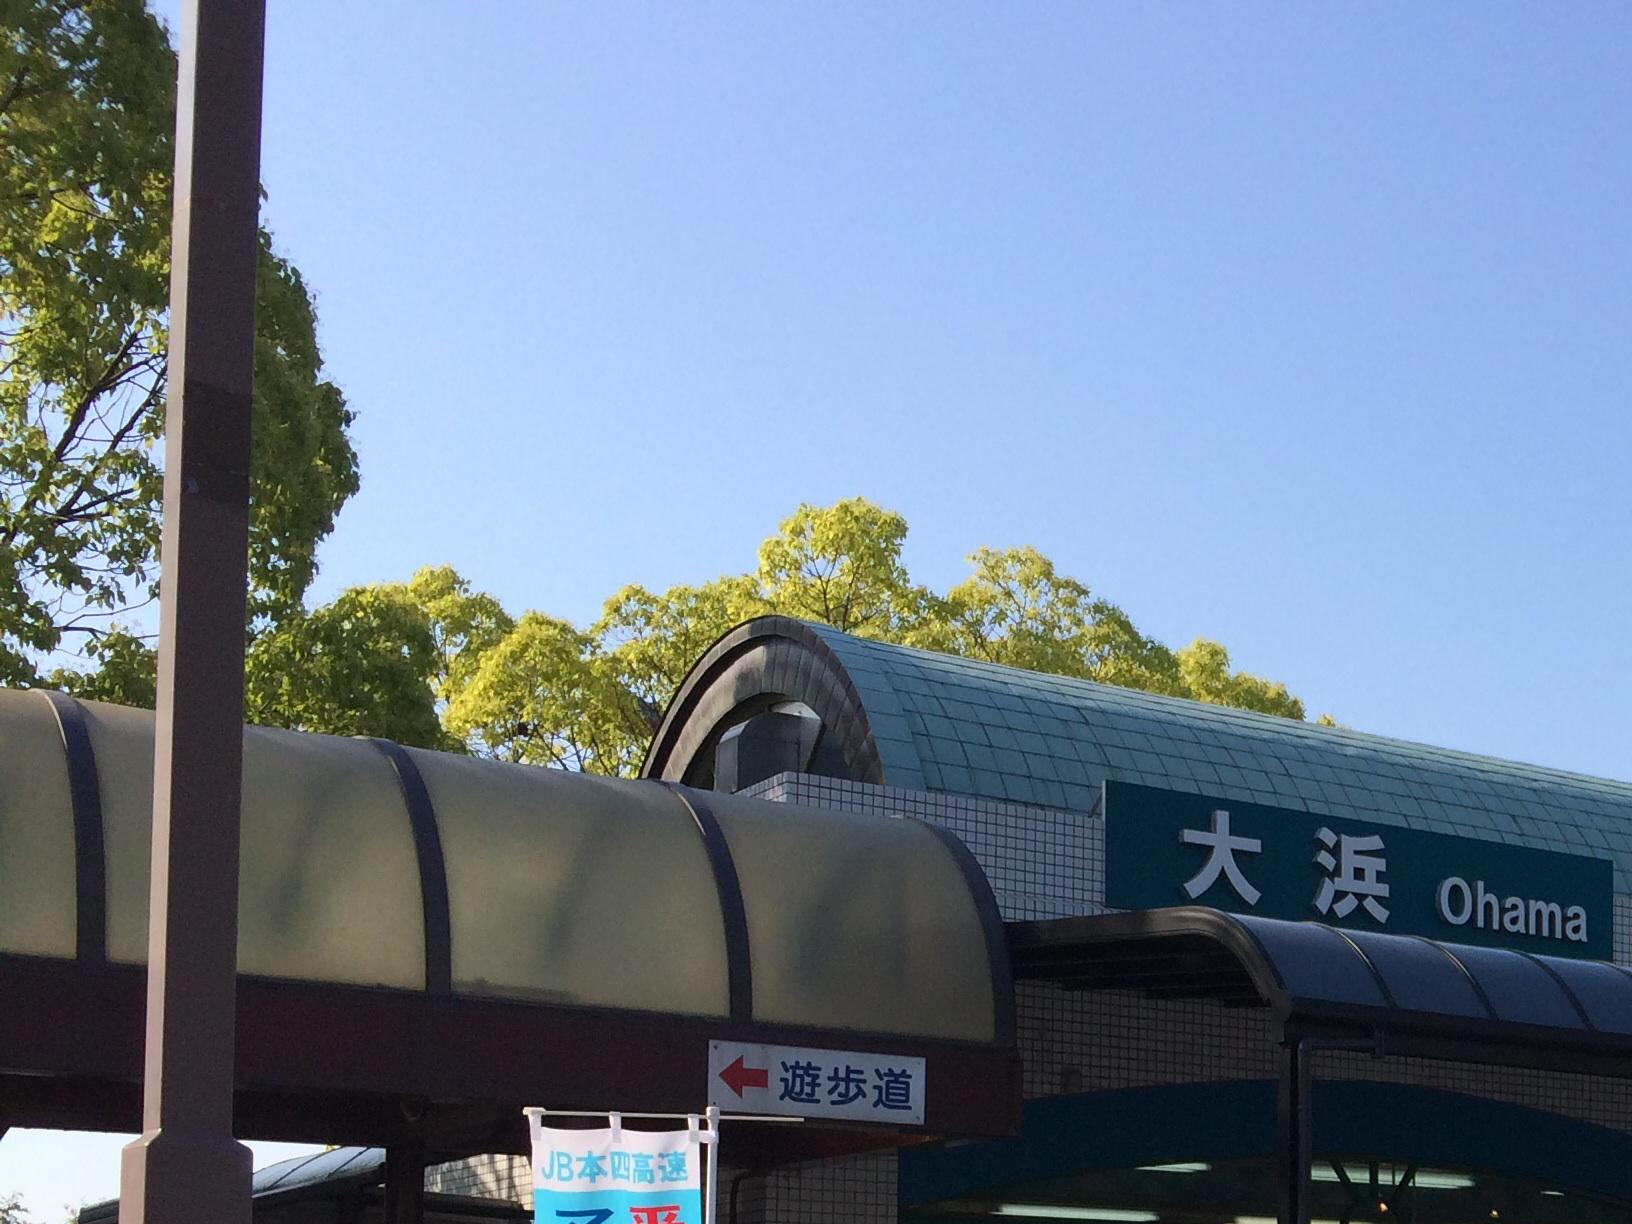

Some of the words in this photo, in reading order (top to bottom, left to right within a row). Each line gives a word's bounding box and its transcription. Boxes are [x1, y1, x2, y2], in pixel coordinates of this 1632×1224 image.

[1178, 809, 1391, 924] 大浜
[1436, 876, 1588, 942] Ohama
[778, 1060, 912, 1111] 遊歩道
[542, 1151, 688, 1184] JB本四高速
